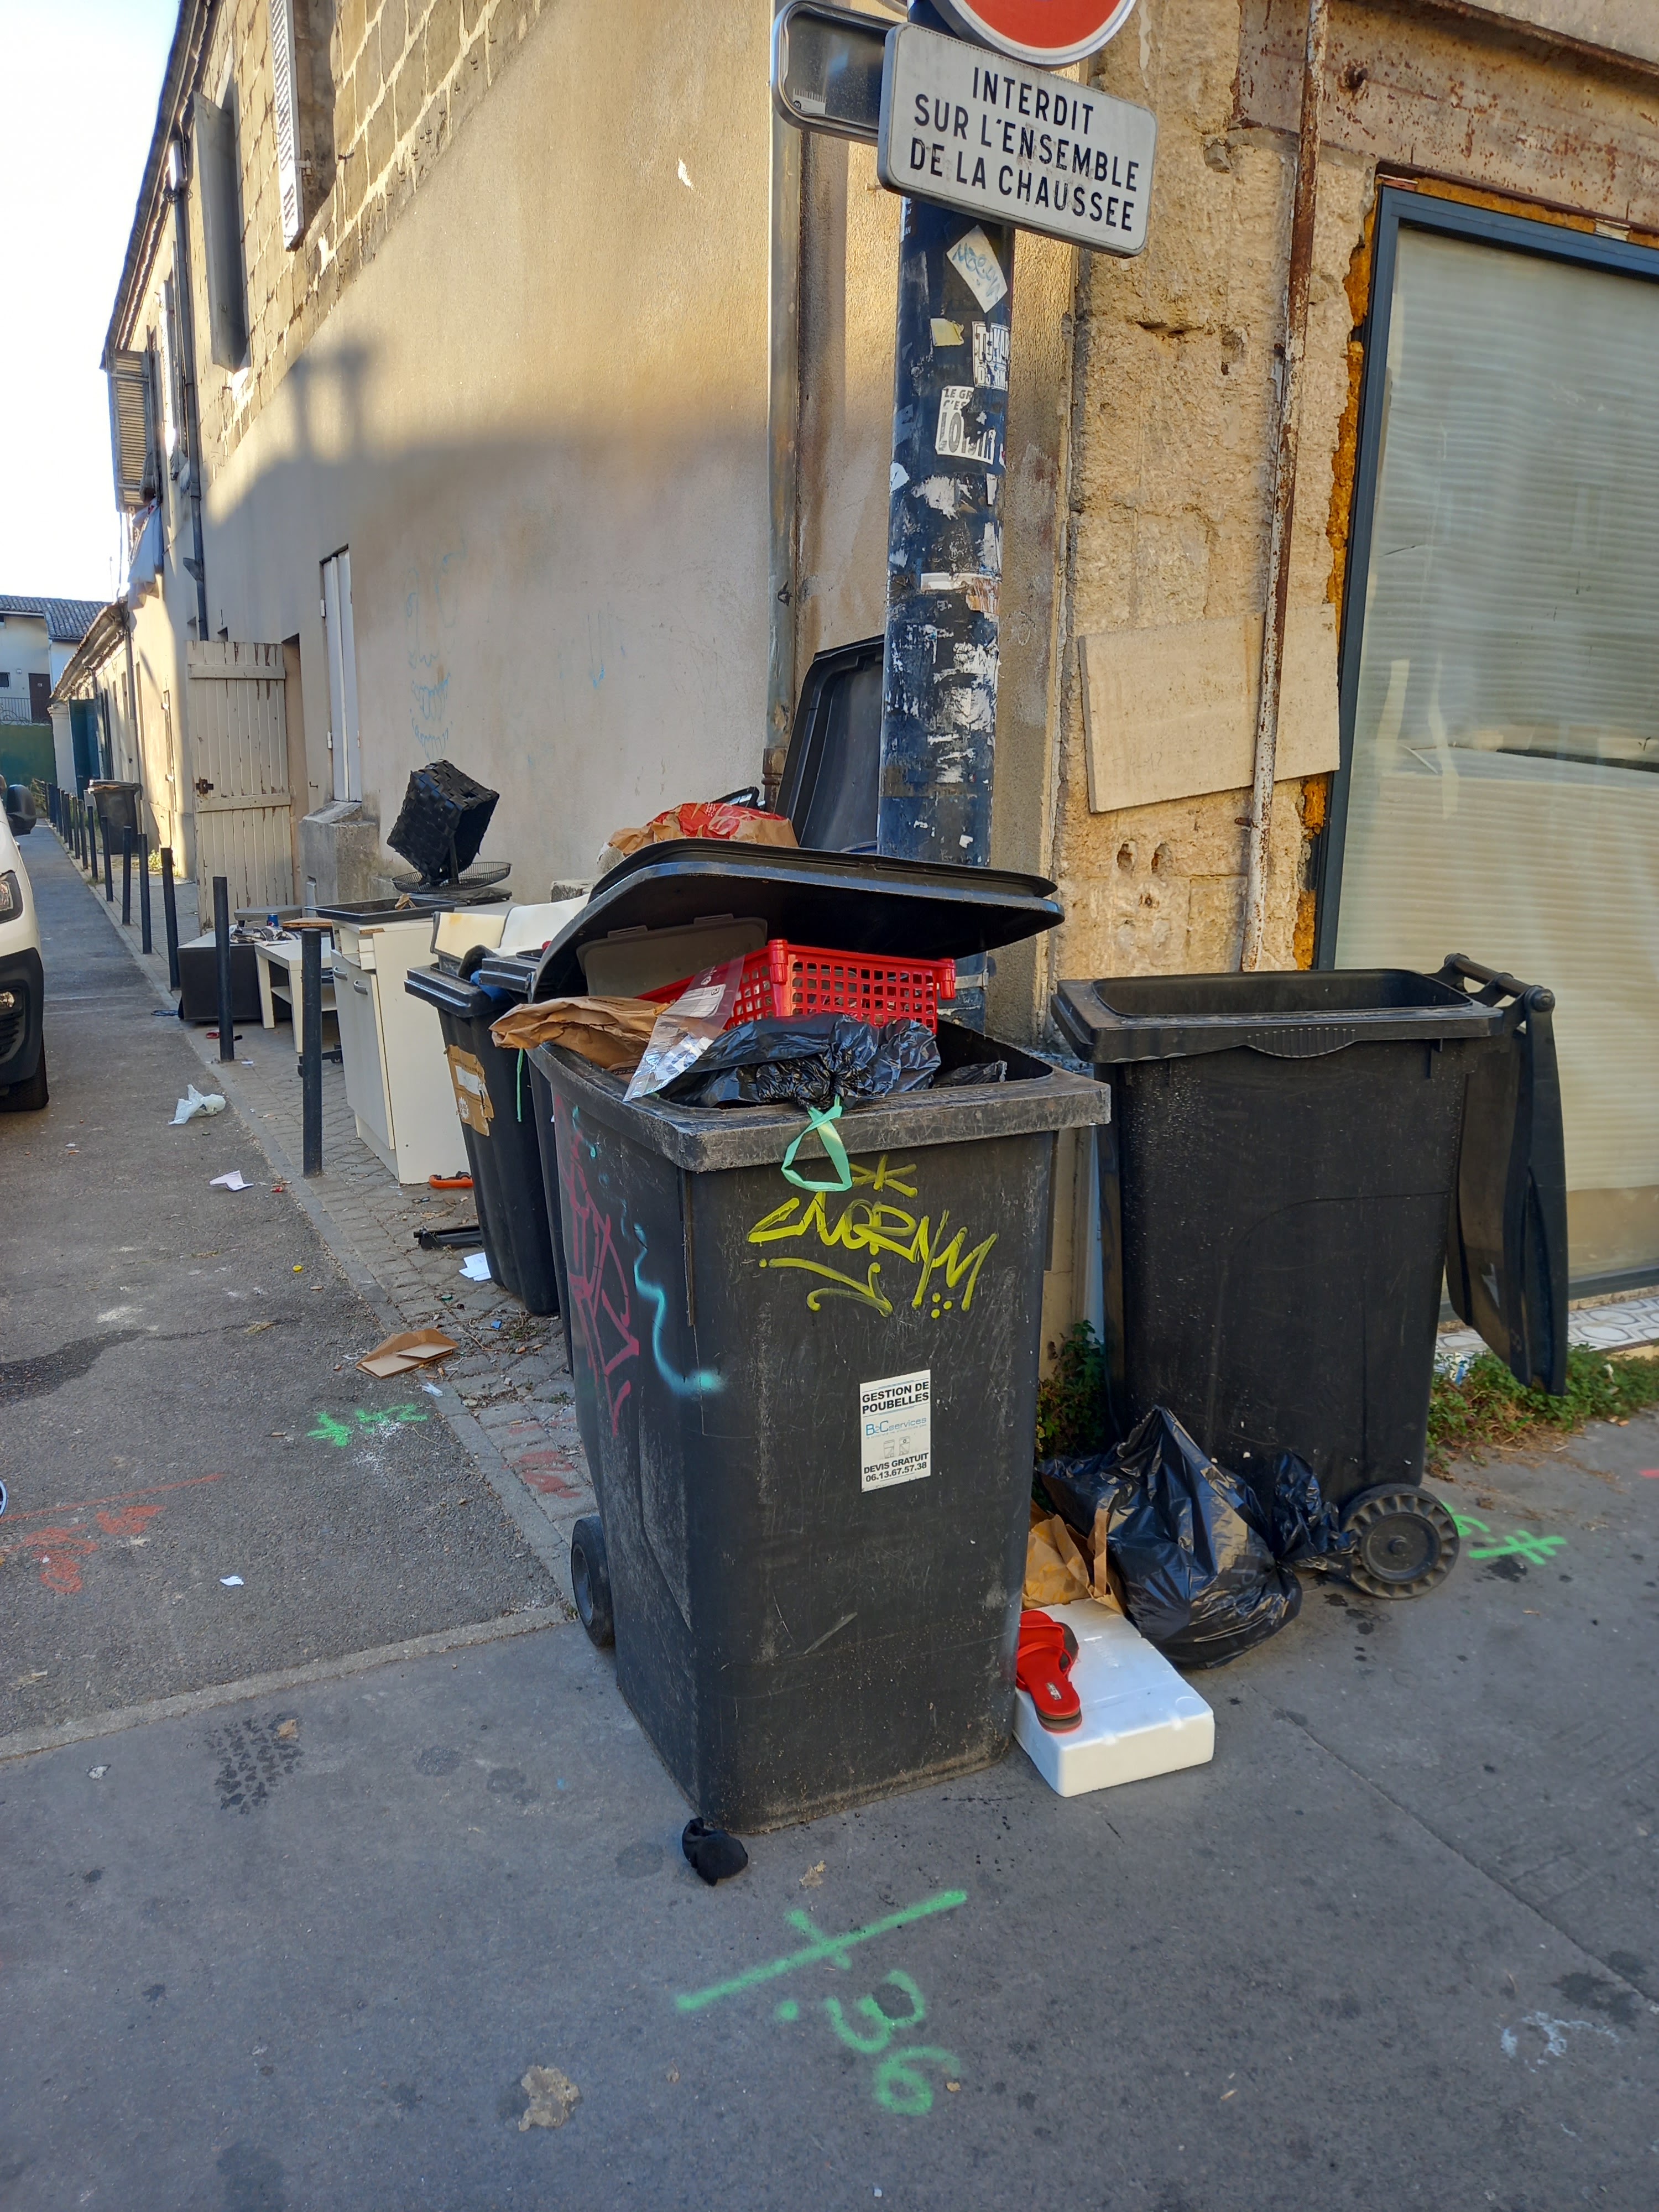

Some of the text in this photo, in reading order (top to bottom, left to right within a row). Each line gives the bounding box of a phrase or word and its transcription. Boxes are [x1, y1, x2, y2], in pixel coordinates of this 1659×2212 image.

[972, 66, 1093, 134] INTERDIT
[915, 93, 1139, 192] SUR L'ENSEMBLE
[910, 137, 1134, 232] DE LA CHAUSSEE
[945, 388, 957, 398] LE
[862, 1381, 929, 1403] GESTION DE
[862, 1392, 929, 1414] POUBELLES
[864, 1453, 929, 1474] DEVIS GRATUIT
[865, 1462, 927, 1482] 06.13.67.57.38
